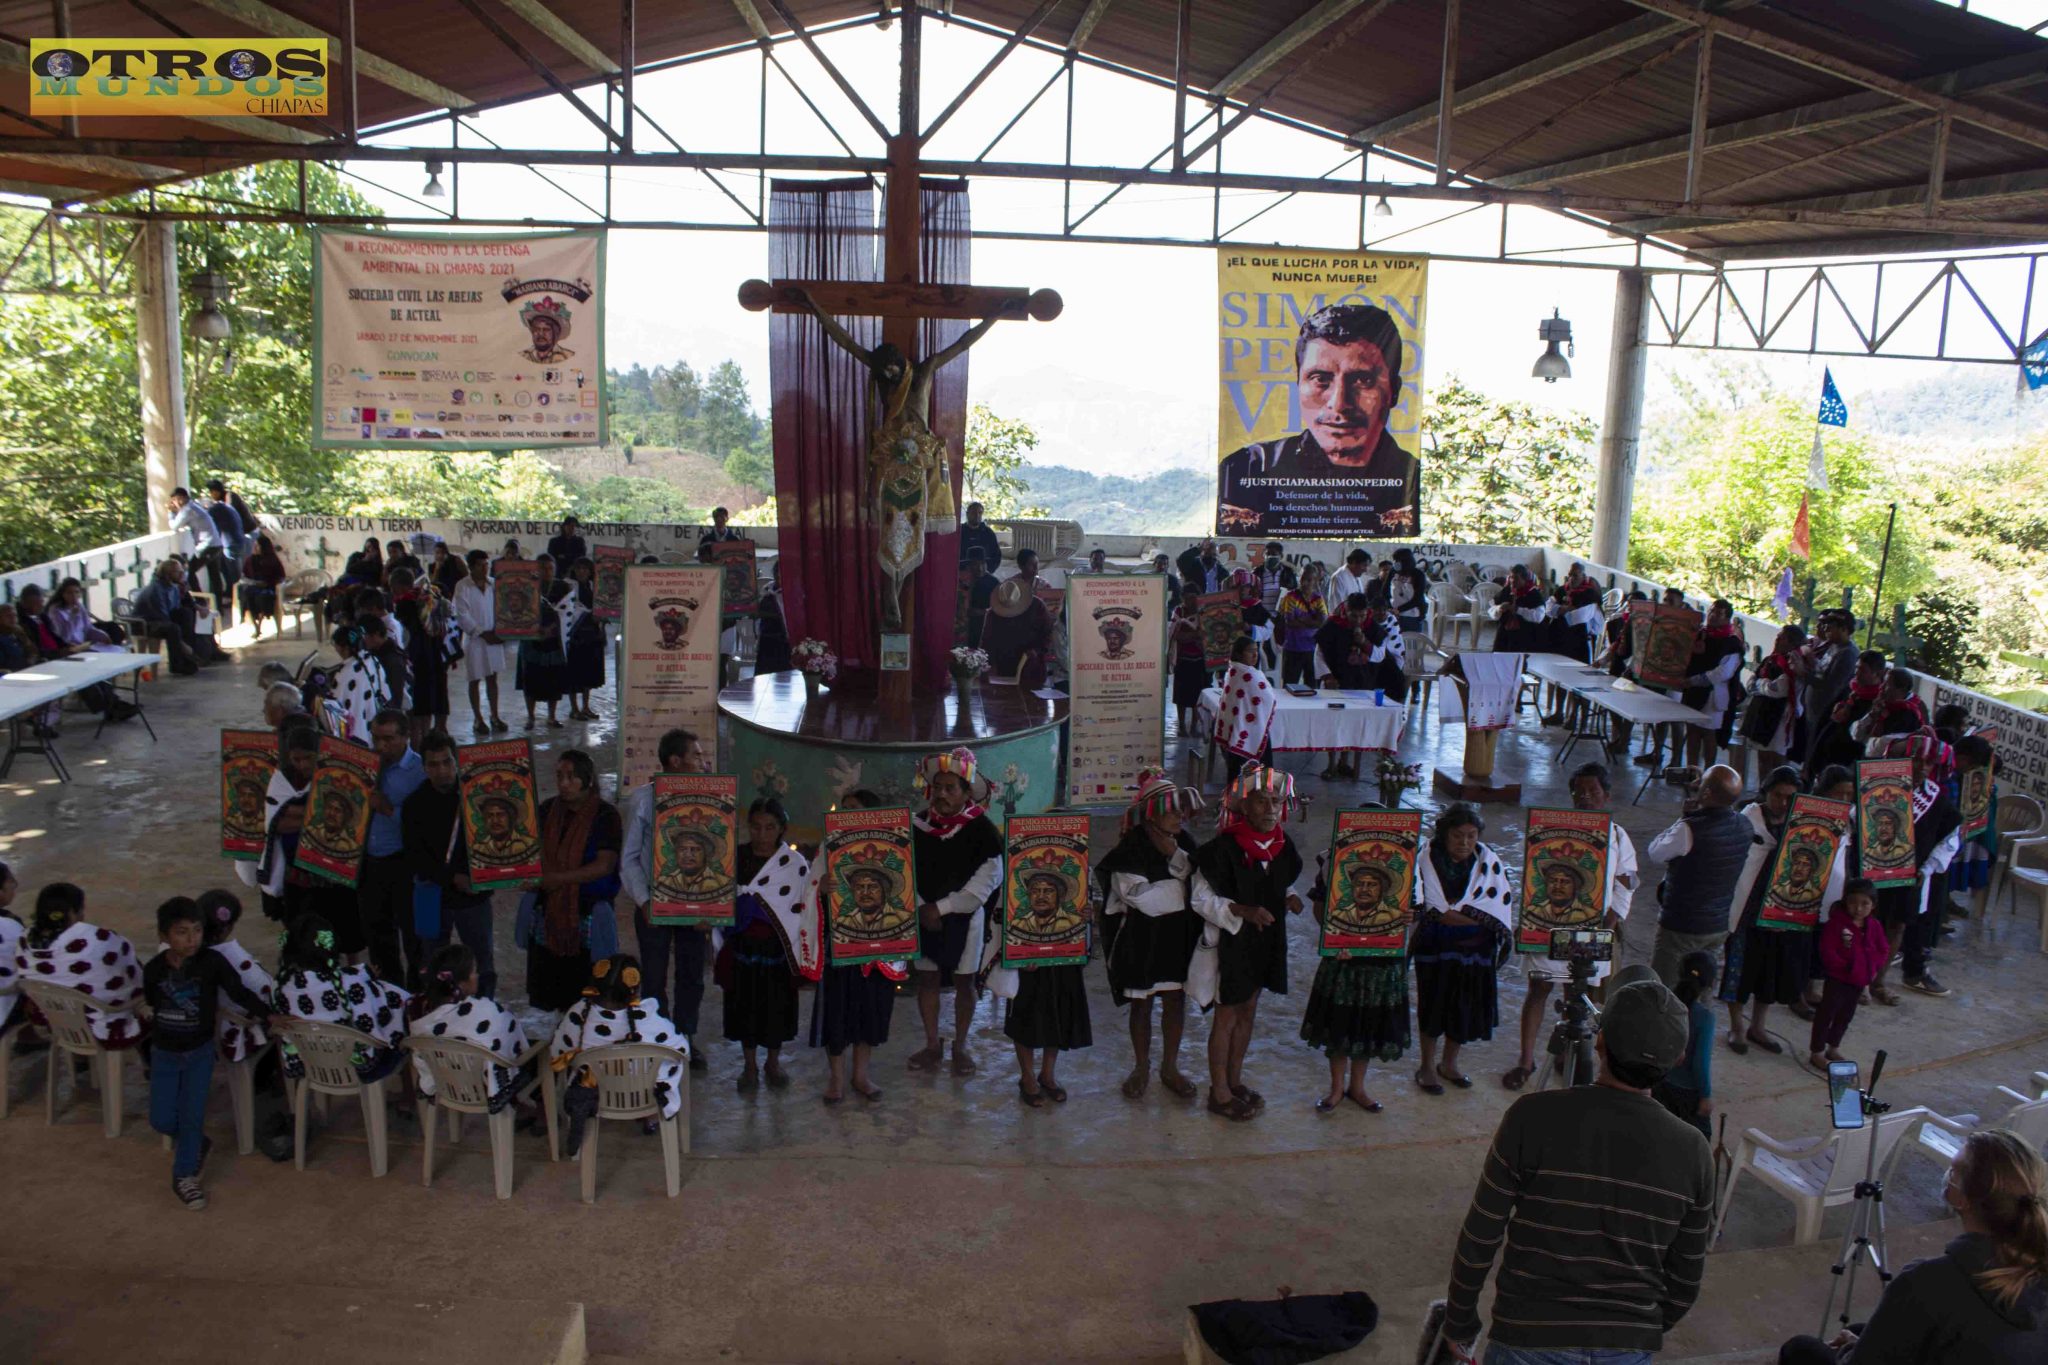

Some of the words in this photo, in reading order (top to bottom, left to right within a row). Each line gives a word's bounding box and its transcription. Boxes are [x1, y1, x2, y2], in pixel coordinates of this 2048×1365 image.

[358, 241, 448, 256] RECONOCIMIENTO
[453, 244, 461, 256] A
[465, 244, 478, 256] LA
[483, 243, 531, 256] DEFENSA
[362, 260, 421, 274] AMBIENTAL
[426, 262, 439, 274] EN
[444, 262, 484, 275] CHIAPAS
[490, 263, 514, 275] 2021
[1252, 257, 1279, 267] QUE
[1284, 258, 1328, 268] LUCHA
[1332, 259, 1359, 269] POR
[1363, 259, 1378, 269] LA
[1384, 260, 1420, 271] VIDA,
[1272, 272, 1321, 282] NUNCA
[1327, 273, 1377, 283] MUERE!
[348, 288, 394, 302] SOCIEDAD
[397, 289, 423, 303] CIVIL
[426, 290, 444, 303] LAS
[448, 290, 483, 303] ABEJAS
[390, 308, 403, 321] DE
[406, 308, 442, 322] ACTEAL
[1239, 478, 1403, 488] #JUSTICIAPARASIMONPEDRO
[1275, 490, 1319, 500] Defensor
[1320, 491, 1333, 500] de
[1334, 490, 1345, 500] la
[1345, 491, 1369, 501] vida,
[1269, 503, 1283, 512] los
[1285, 503, 1328, 512] derechos
[1330, 503, 1375, 512] humanos
[1281, 517, 1288, 526] y
[1289, 515, 1299, 524] la
[1301, 515, 1331, 524] madre
[1333, 515, 1362, 524] tierra.
[338, 518, 354, 531] EN
[358, 518, 373, 531] LA
[379, 518, 422, 532] TIERRA
[463, 520, 522, 534] SAGRADA
[526, 522, 542, 535] DE
[674, 526, 691, 539] DE
[1413, 545, 1454, 557] ACTEAL
[1976, 701, 1988, 717] EN
[1991, 706, 2012, 726] DIOS
[2016, 716, 2032, 732] NO
[2008, 731, 2023, 748] UN
[2029, 758, 2046, 777] EN
